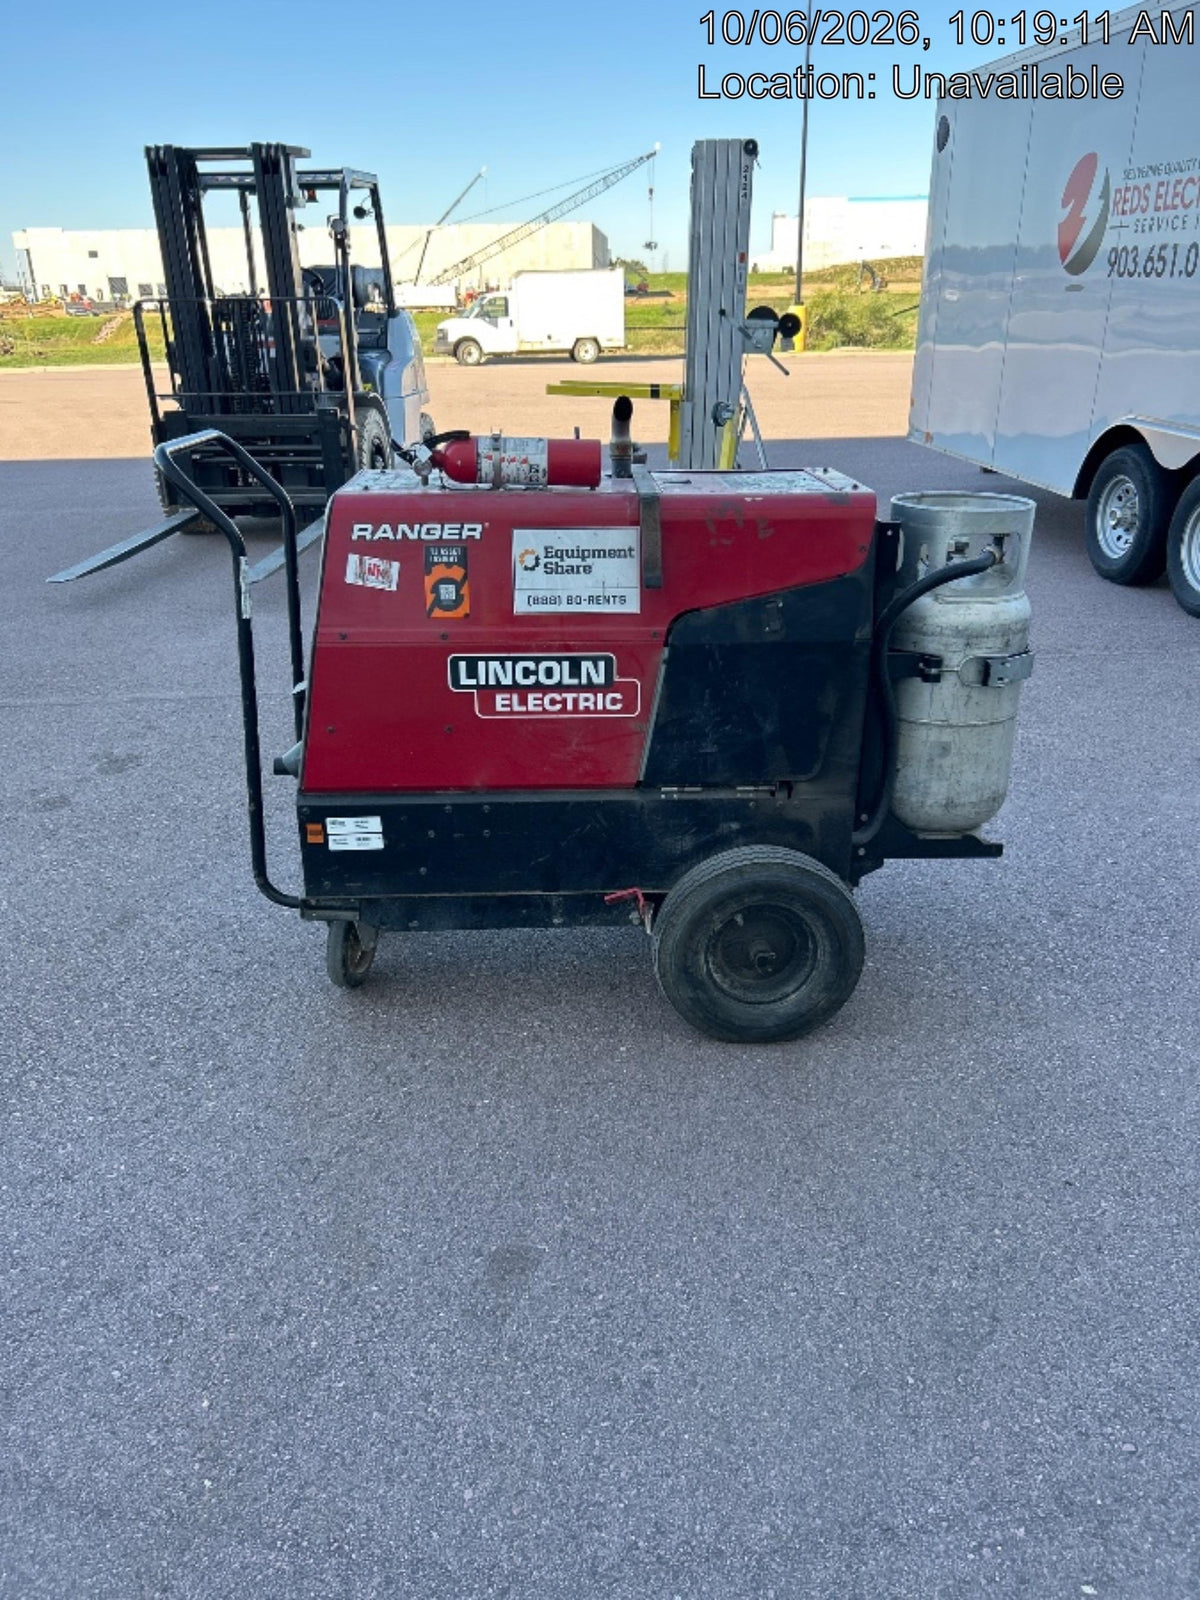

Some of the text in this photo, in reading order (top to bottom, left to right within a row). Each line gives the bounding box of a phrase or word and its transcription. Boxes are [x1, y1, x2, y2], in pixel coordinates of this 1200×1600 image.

[1112, 183, 1150, 216] REDS
[1134, 214, 1188, 233] SERVICE
[1107, 241, 1199, 277] 903.651.0
[351, 523, 483, 541] RANGER
[543, 545, 635, 562] Equipment
[543, 561, 593, 575] Share
[458, 661, 606, 686] LINCOLN
[495, 693, 623, 712] ELECTRIC
